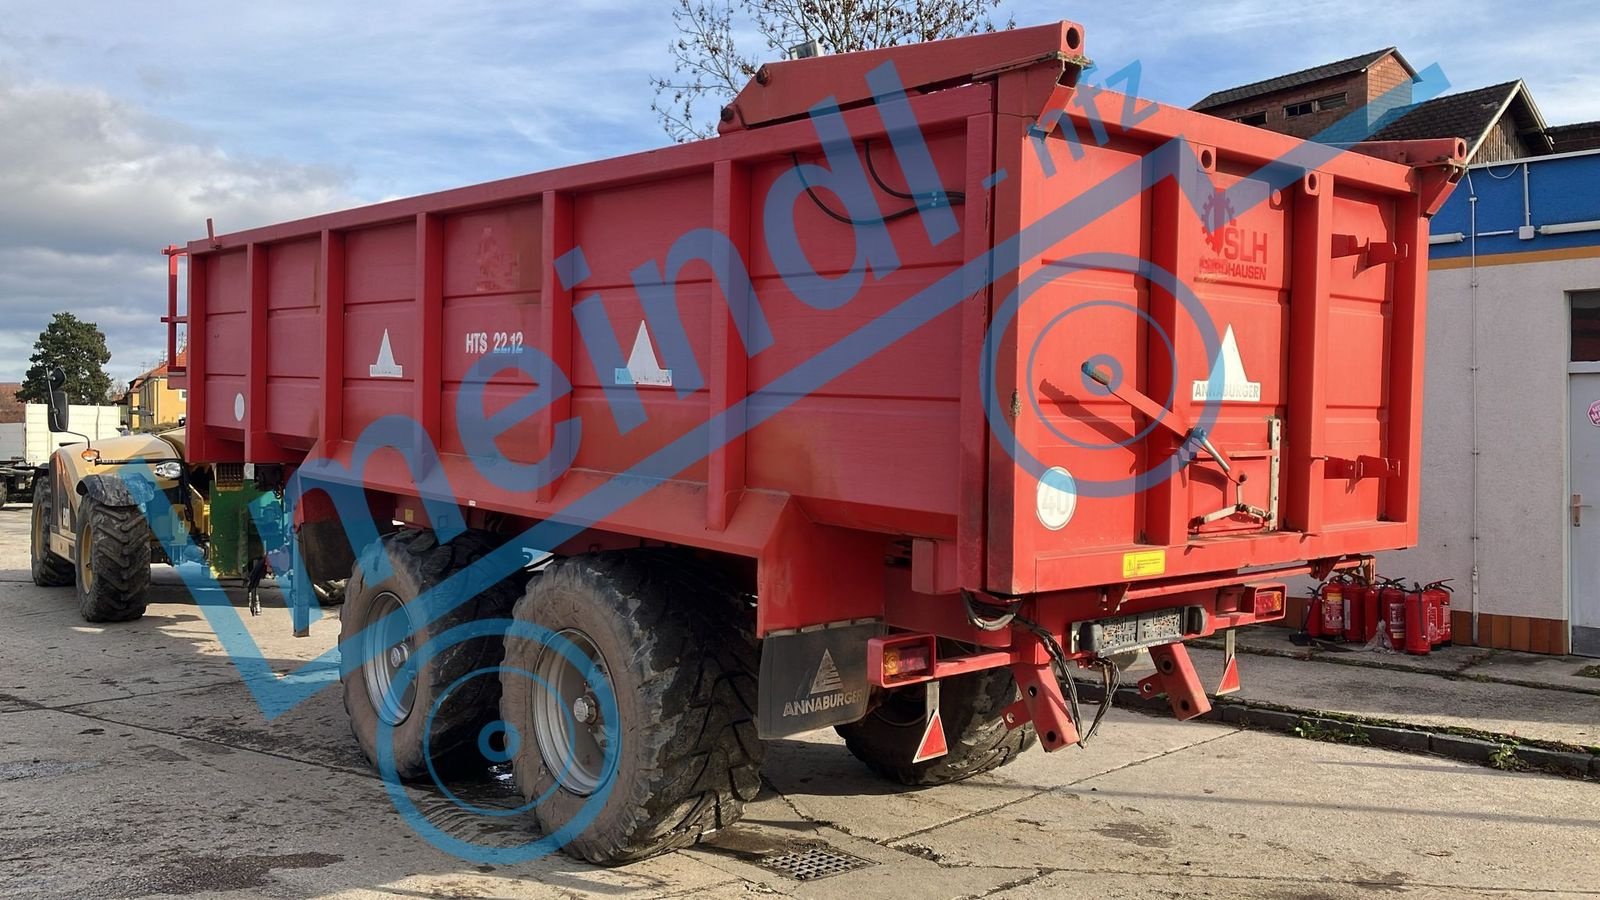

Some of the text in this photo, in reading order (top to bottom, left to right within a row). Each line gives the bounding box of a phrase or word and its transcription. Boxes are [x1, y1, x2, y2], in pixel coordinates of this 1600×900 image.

[1224, 227, 1268, 264] SLH
[465, 331, 524, 354] HTS 22.12
[1041, 479, 1071, 517] 40
[783, 689, 863, 717] ANNABURGER
